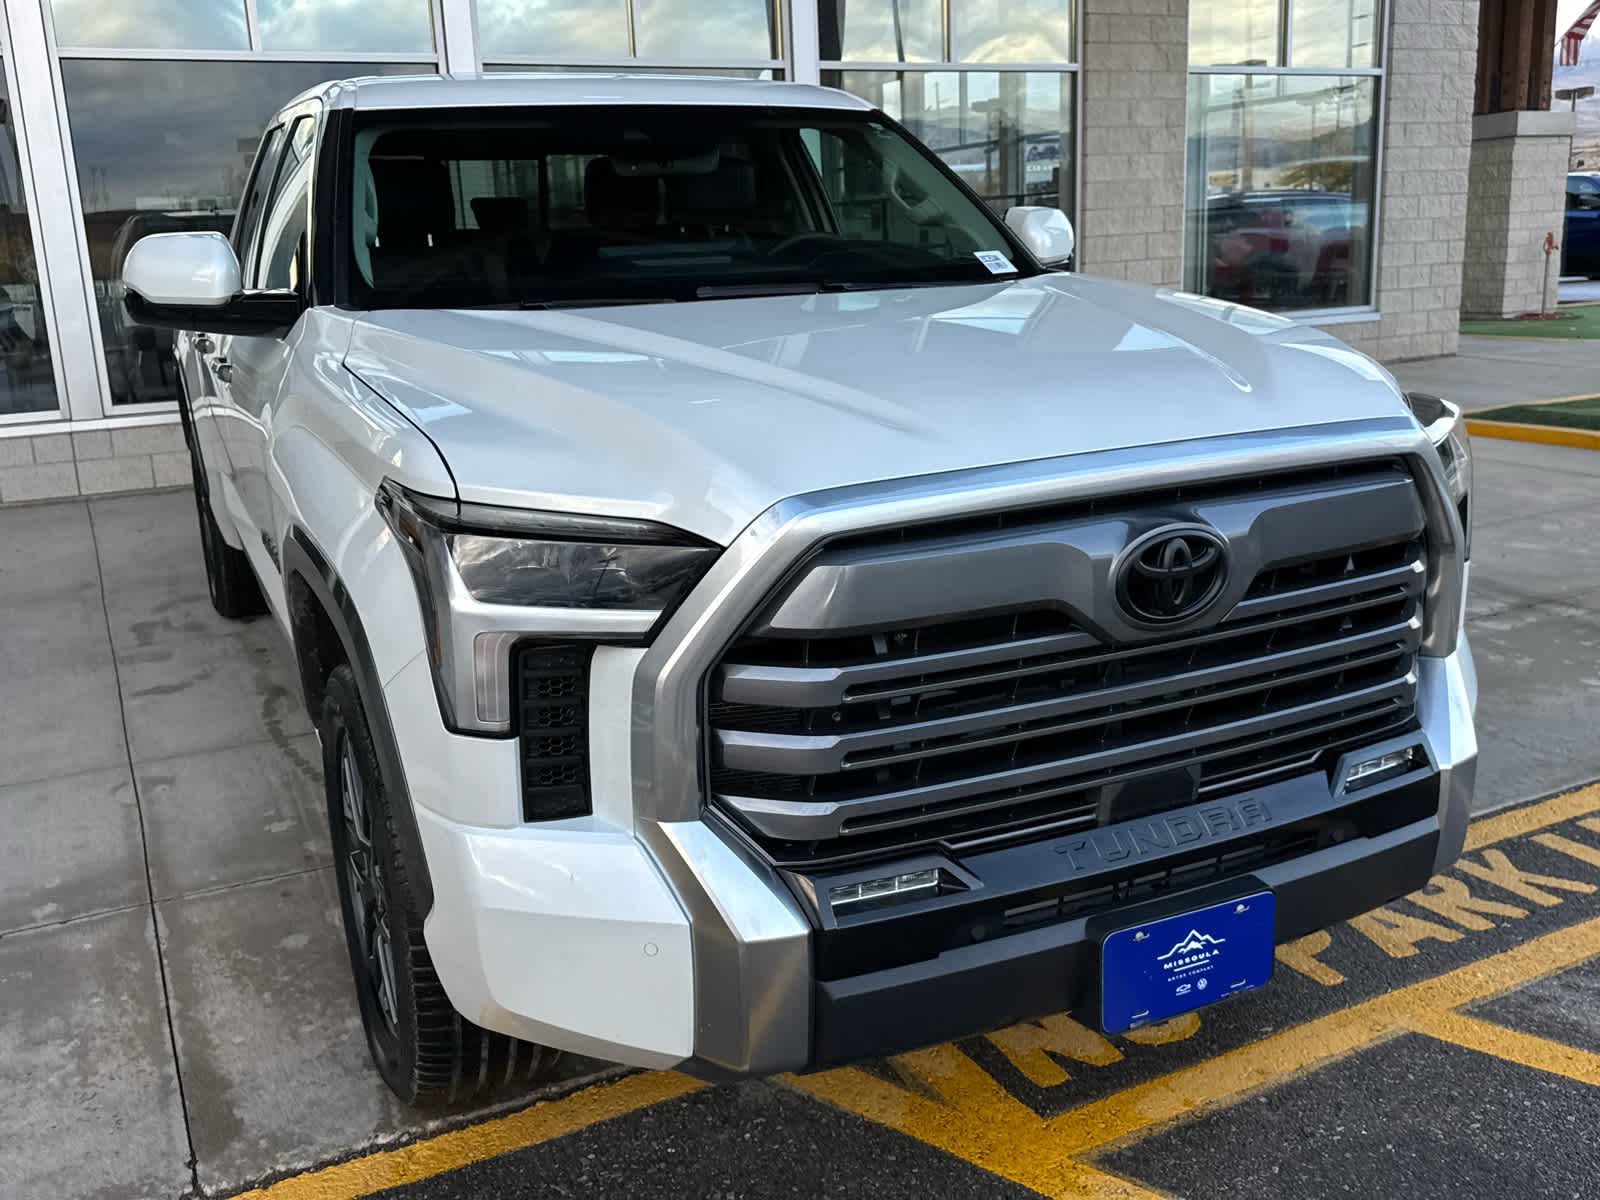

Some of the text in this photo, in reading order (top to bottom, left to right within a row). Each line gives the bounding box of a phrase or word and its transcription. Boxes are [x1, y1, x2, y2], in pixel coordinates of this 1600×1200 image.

[1054, 798, 1273, 871] TUNDRA
[1275, 818, 1600, 986] PARKI
[1163, 949, 1220, 970] MISSOULA
